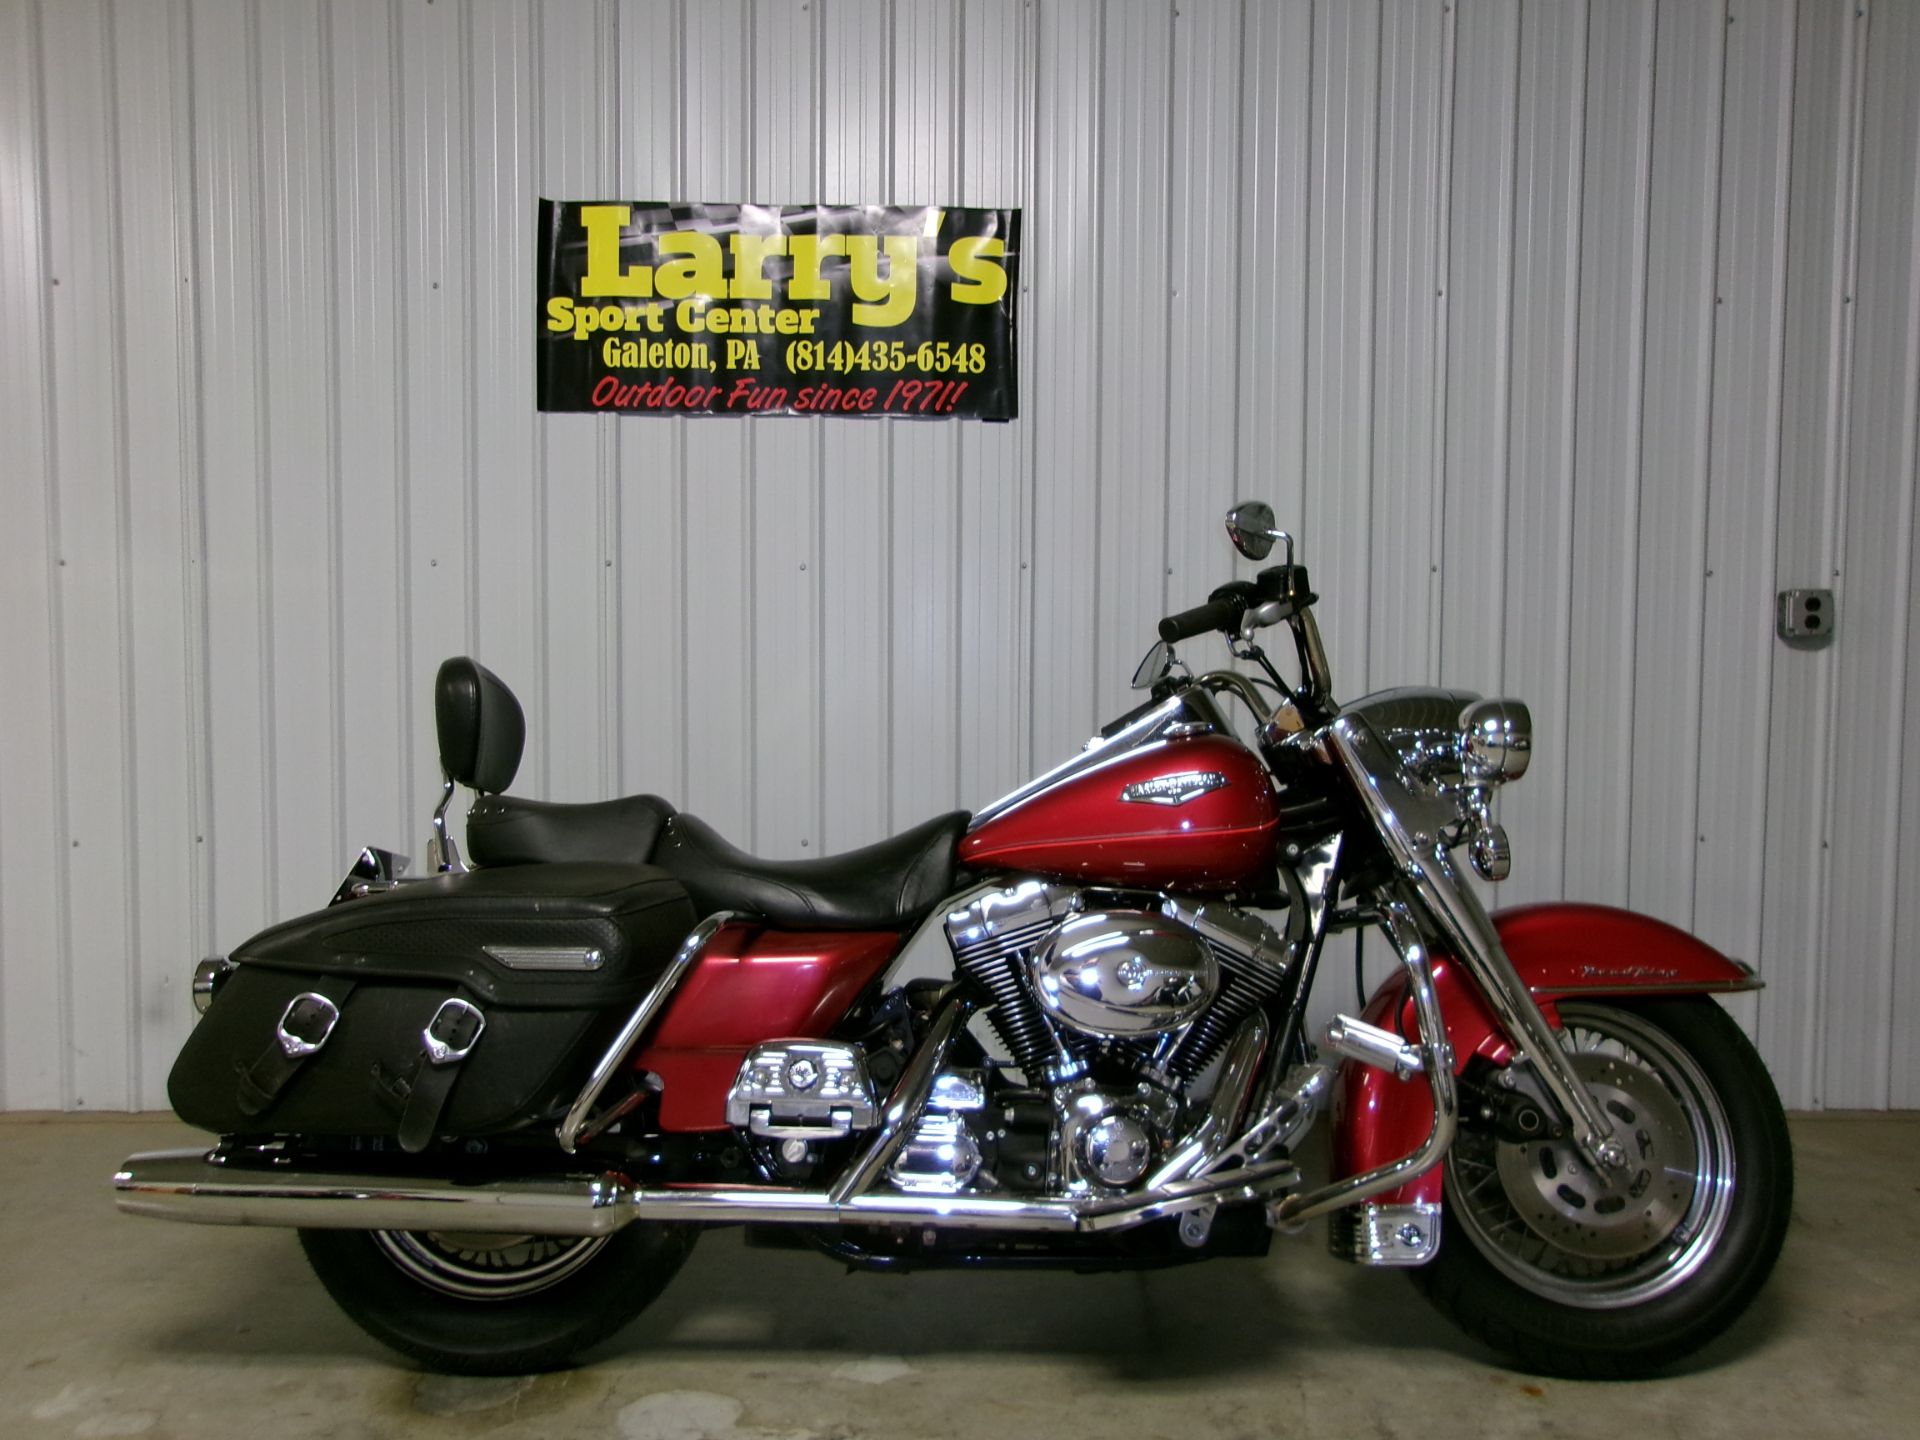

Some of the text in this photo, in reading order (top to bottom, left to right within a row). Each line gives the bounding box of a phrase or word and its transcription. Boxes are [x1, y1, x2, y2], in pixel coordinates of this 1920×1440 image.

[580, 205, 1008, 328] Larry's
[546, 296, 821, 341] Sport Center
[602, 336, 987, 375] Galeton, PA (814)435-6548
[591, 374, 723, 409] Outdoor
[726, 376, 789, 410] Fun
[793, 382, 879, 411] since
